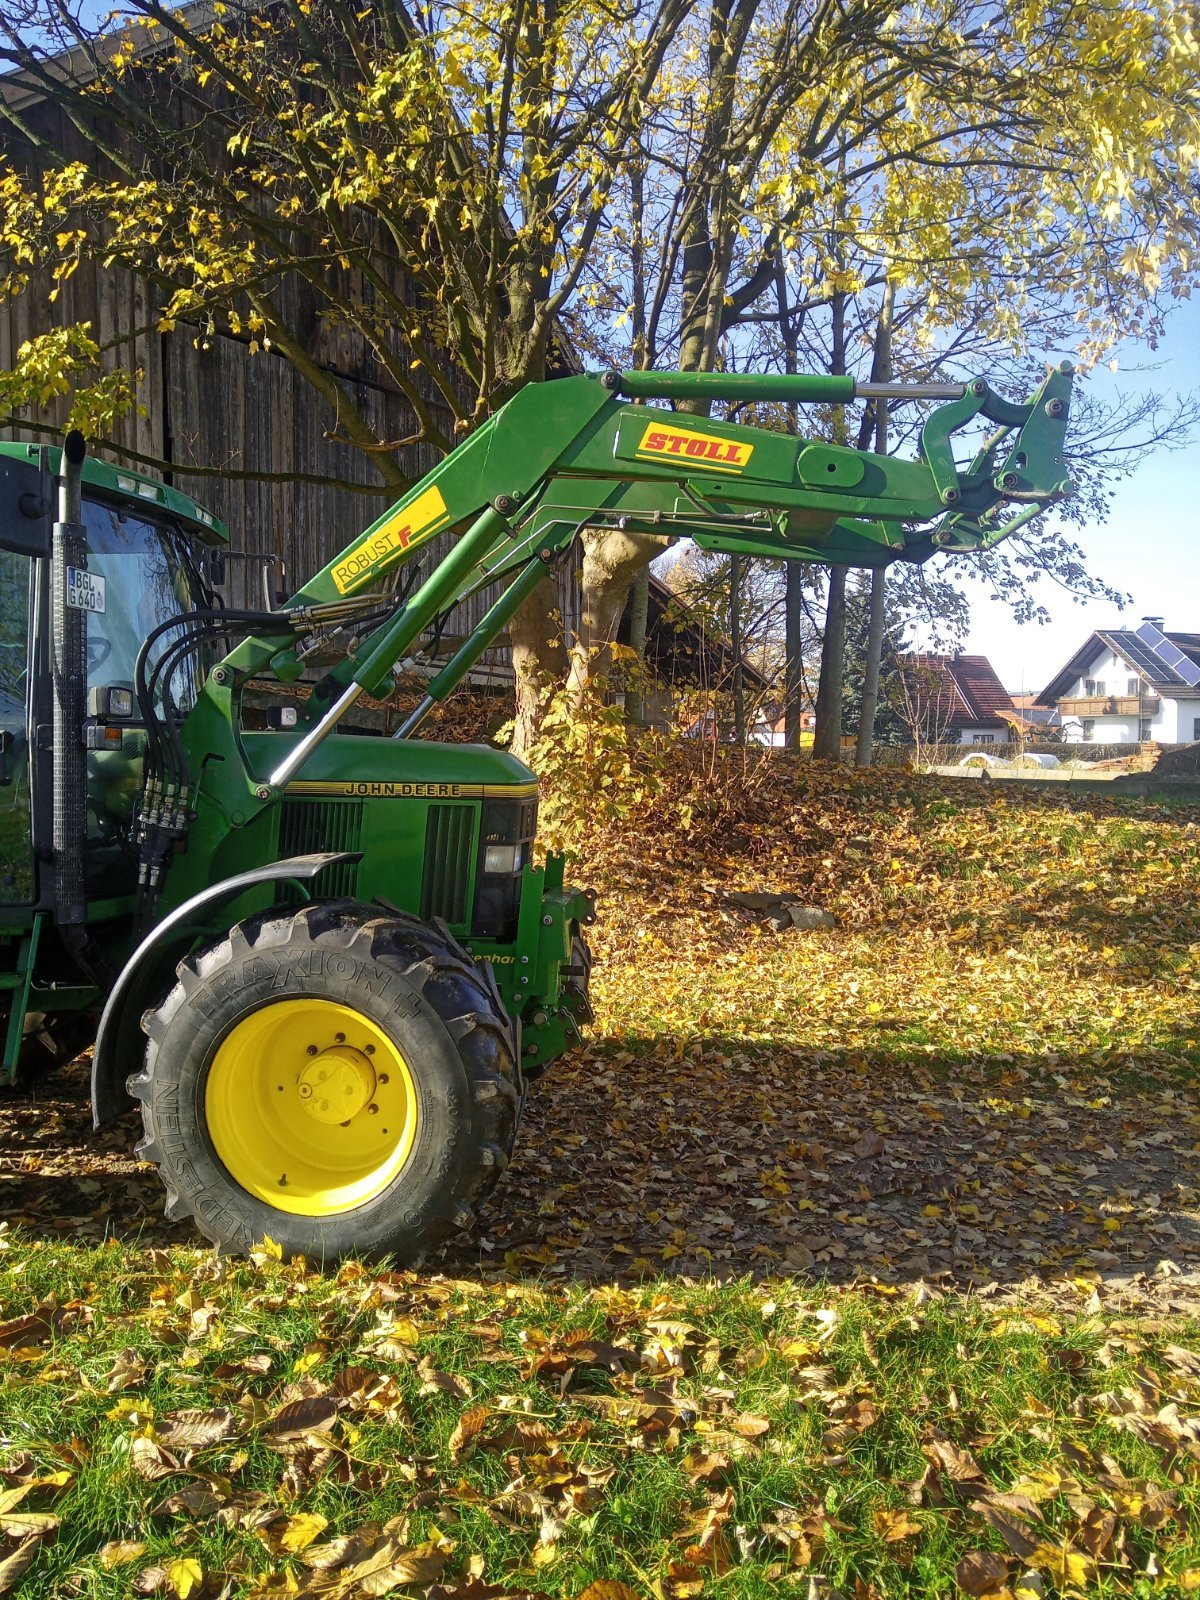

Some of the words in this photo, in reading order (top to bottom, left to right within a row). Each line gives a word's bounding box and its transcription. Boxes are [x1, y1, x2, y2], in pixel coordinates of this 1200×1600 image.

[645, 432, 742, 463] STOLL
[336, 533, 395, 583] ROBUST
[398, 524, 412, 548] F
[76, 571, 95, 592] BGL
[78, 590, 95, 609] 640
[345, 782, 396, 796] JOHN
[401, 783, 461, 797] DEERE
[187, 949, 393, 1017] TRAXION
[156, 1079, 262, 1252] REDESTEIN
